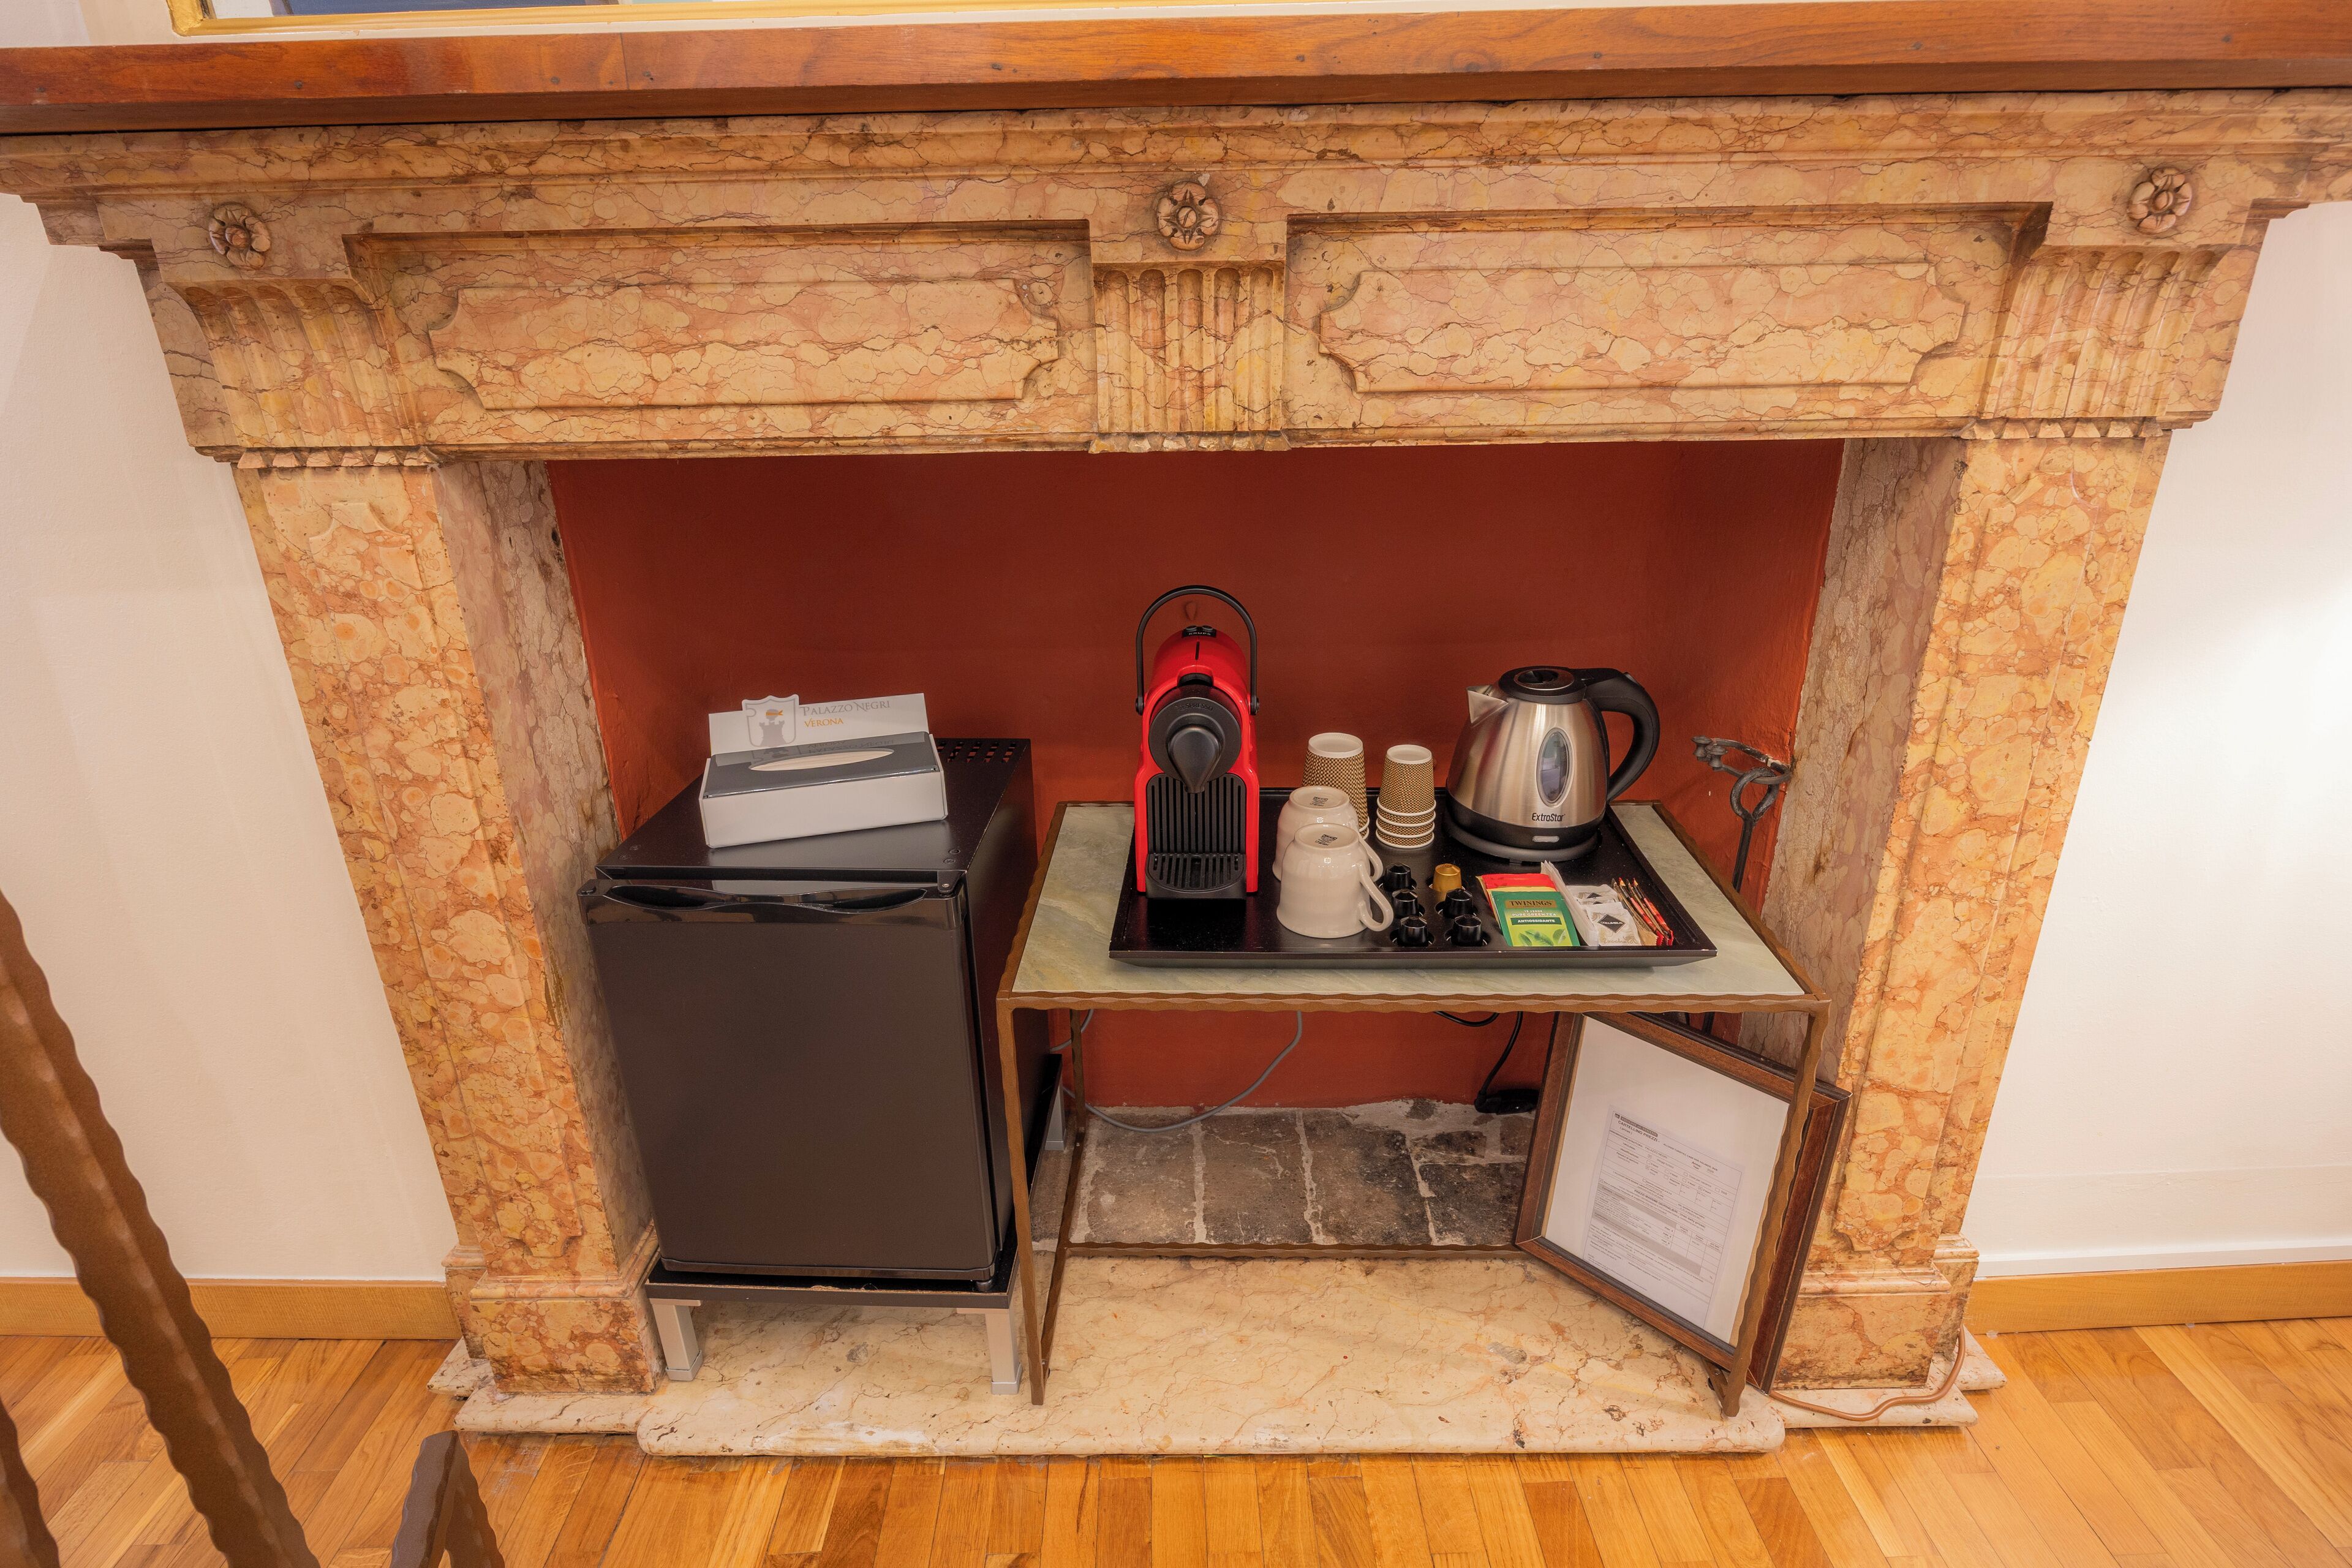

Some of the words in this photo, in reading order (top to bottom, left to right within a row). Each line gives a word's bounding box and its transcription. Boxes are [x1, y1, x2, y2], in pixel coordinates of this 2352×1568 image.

[799, 704, 853, 716] PALAZZO
[853, 700, 891, 712] NEGRI
[804, 718, 844, 728] VERONA
[1531, 812, 1564, 822] ExtraStar
[1618, 1120, 1642, 1134] CARTELLINO
[1643, 1132, 1657, 1142] PREZZI
